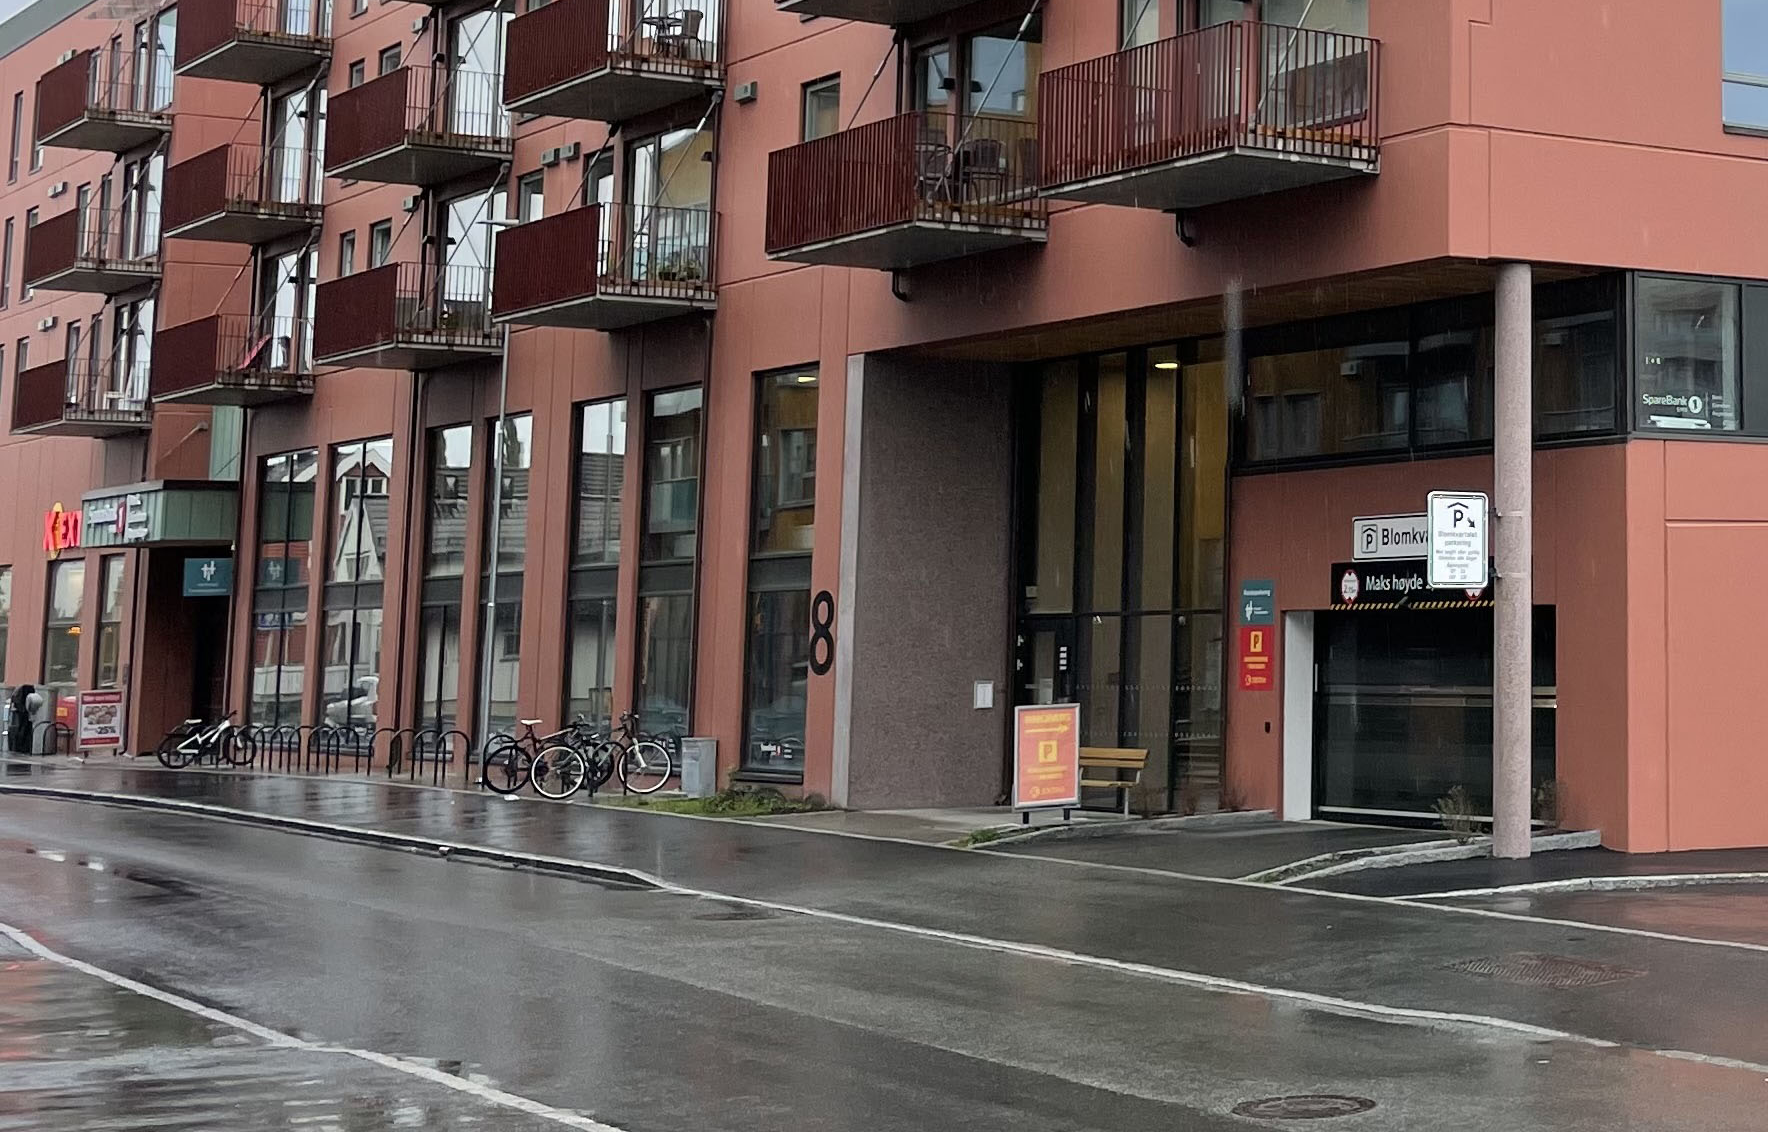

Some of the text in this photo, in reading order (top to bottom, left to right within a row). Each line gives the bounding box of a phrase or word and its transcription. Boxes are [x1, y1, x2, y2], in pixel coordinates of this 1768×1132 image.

[1642, 393, 1688, 406] SpareBank
[1365, 574, 1391, 591] Maks
[1392, 573, 1423, 595] høyde
[808, 590, 835, 676] 8
